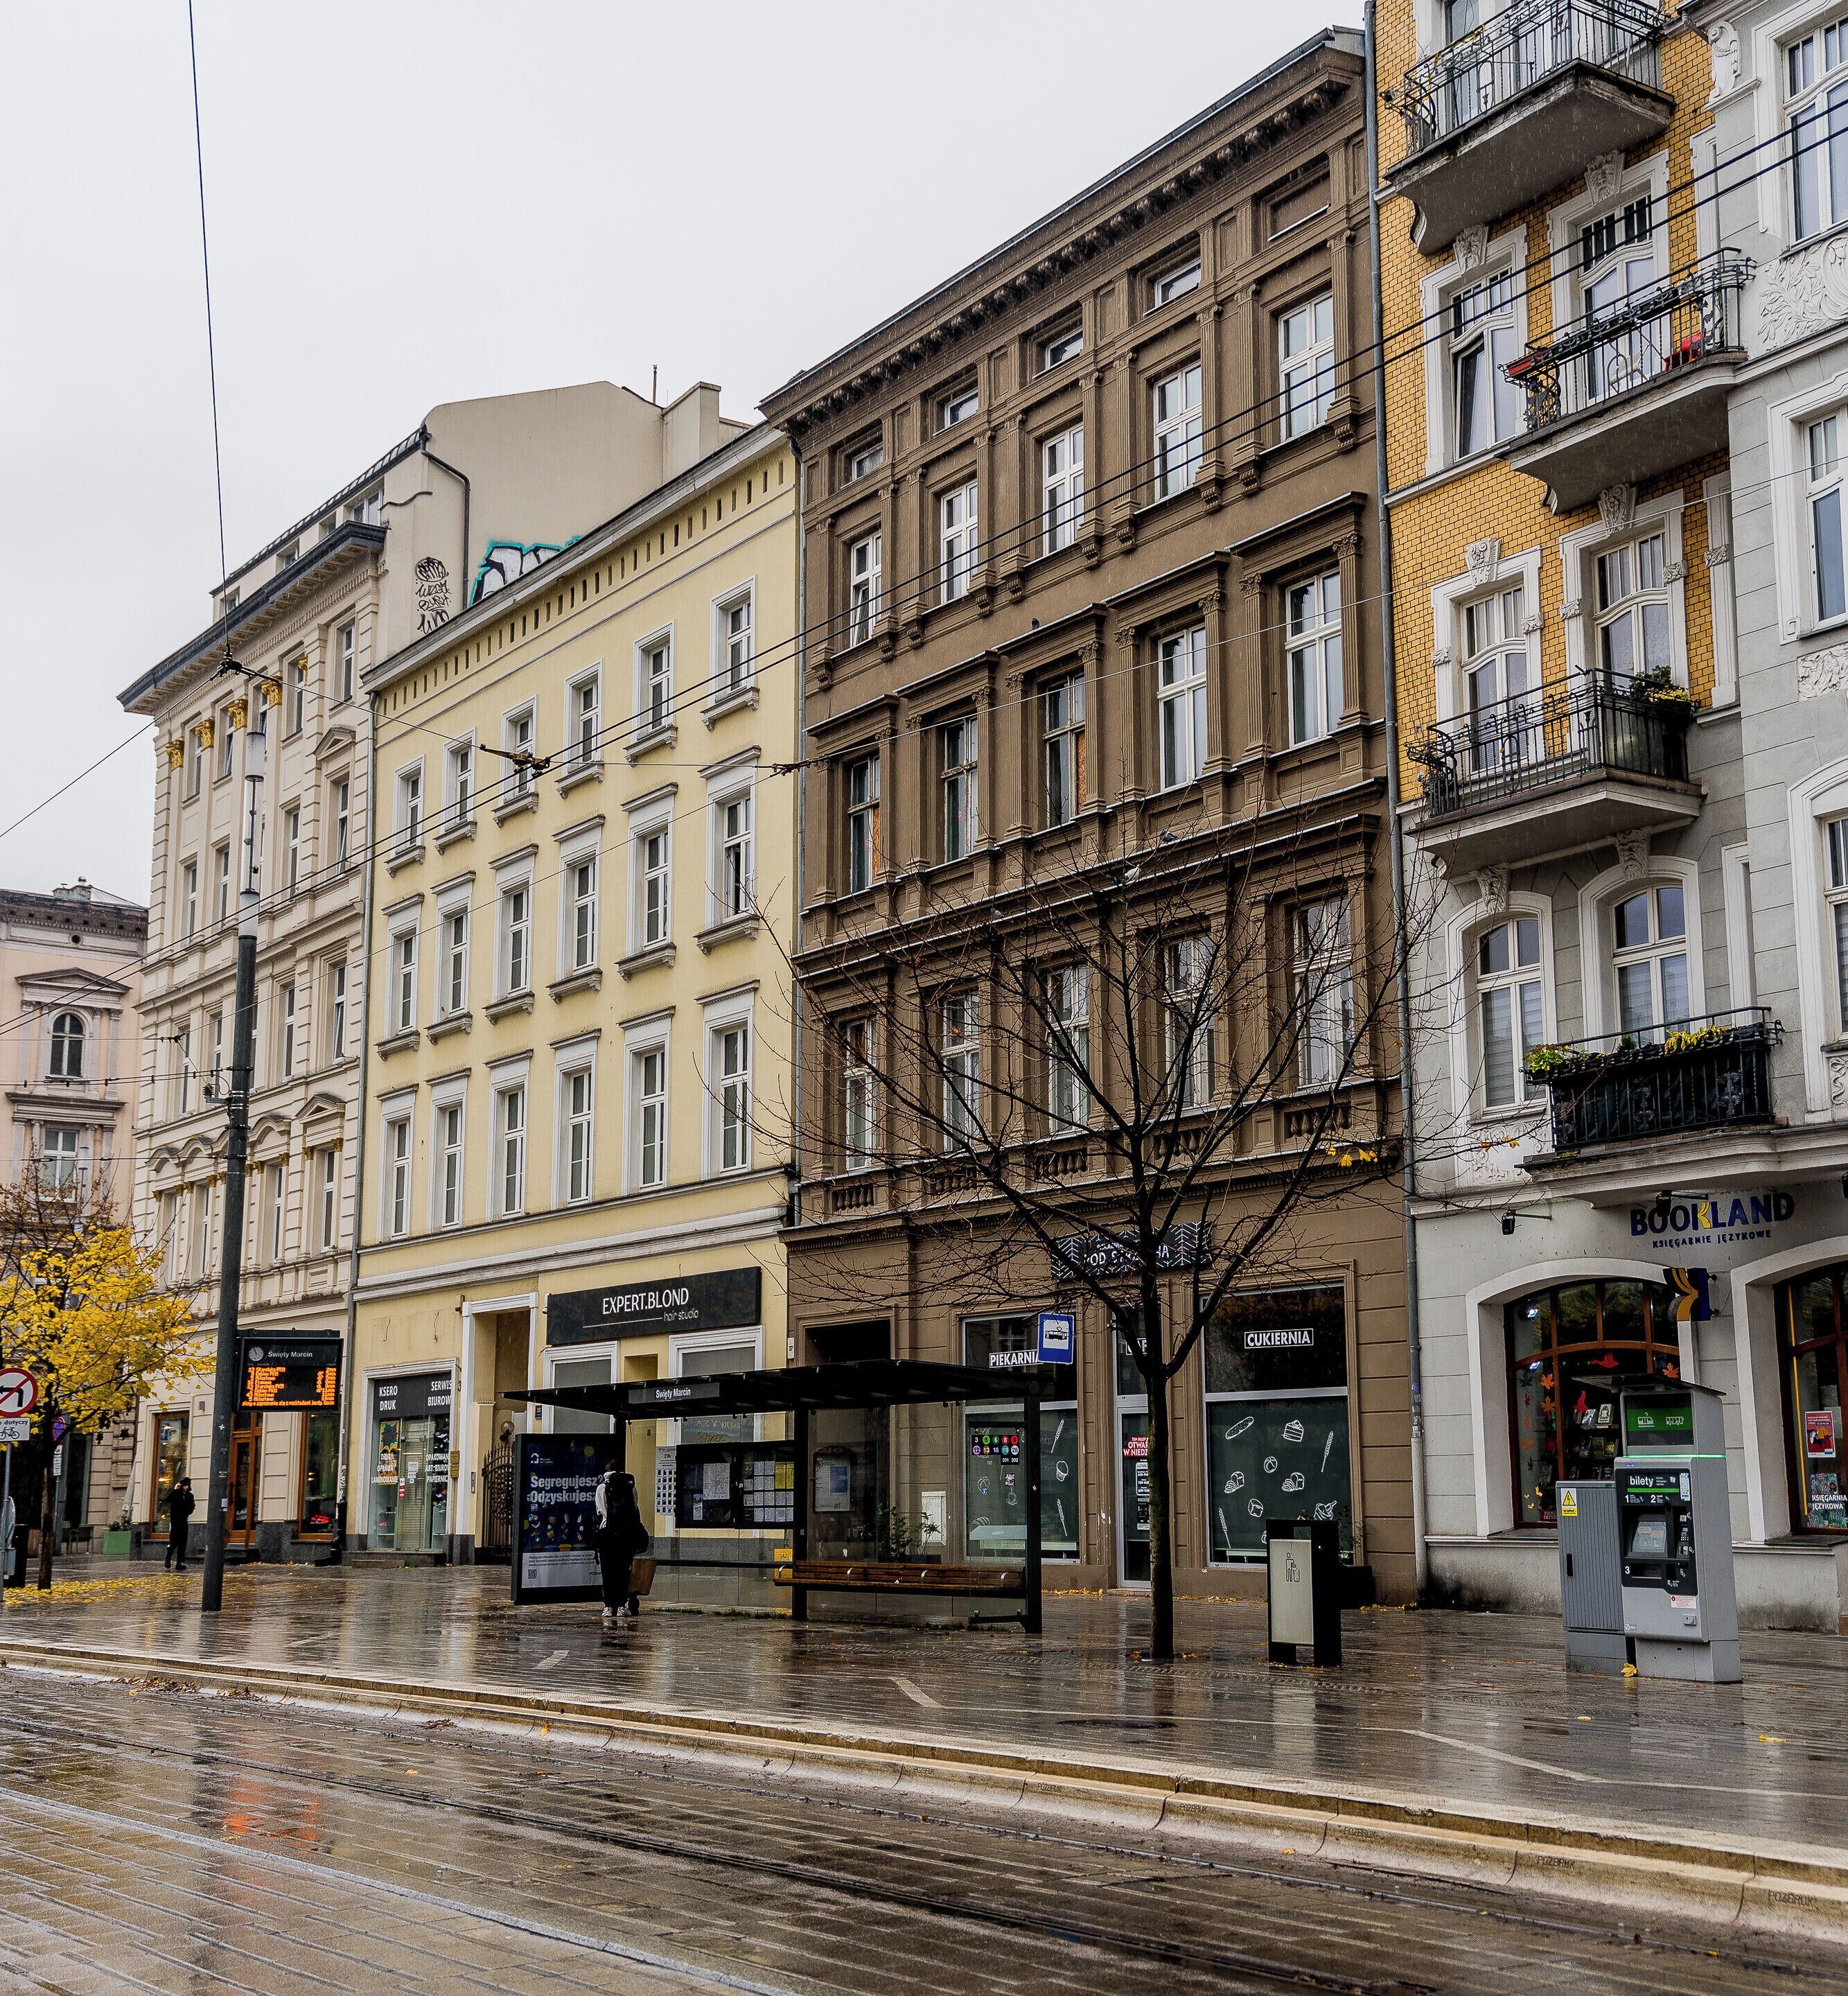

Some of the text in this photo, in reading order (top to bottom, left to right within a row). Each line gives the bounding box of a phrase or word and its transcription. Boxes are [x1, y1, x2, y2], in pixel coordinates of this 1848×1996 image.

[1630, 1193, 1795, 1236] BOOKLAND
[1653, 1230, 1772, 1248] KSIĘGARNIE JĘZYKOWE
[1084, 1252, 1107, 1266] OD
[603, 1288, 689, 1315] EXPERT.BLOND
[664, 1308, 699, 1322] hair studio
[1247, 1331, 1311, 1347] CUKIERNIA
[267, 1350, 290, 1358] Święty
[379, 1385, 398, 1397] KSERO
[431, 1380, 452, 1391] SERWIS
[674, 1387, 691, 1397] Marcin
[380, 1400, 396, 1410] DRUK
[531, 1475, 604, 1490] Segregujesz?
[1630, 1476, 1653, 1487] bilety
[1812, 1494, 1847, 1503] KSIĘGARNIA
[1812, 1503, 1844, 1511] JĘZYKOWA
[1625, 1566, 1630, 1574] 3
[1038, 1783, 1062, 1792] POZBRUK
[1180, 1803, 1208, 1814] POZBRUK
[1344, 1827, 1376, 1839] POZBRUK
[1538, 1856, 1575, 1869] POZBRUK
[1768, 1891, 1815, 1907] POZBRUK
